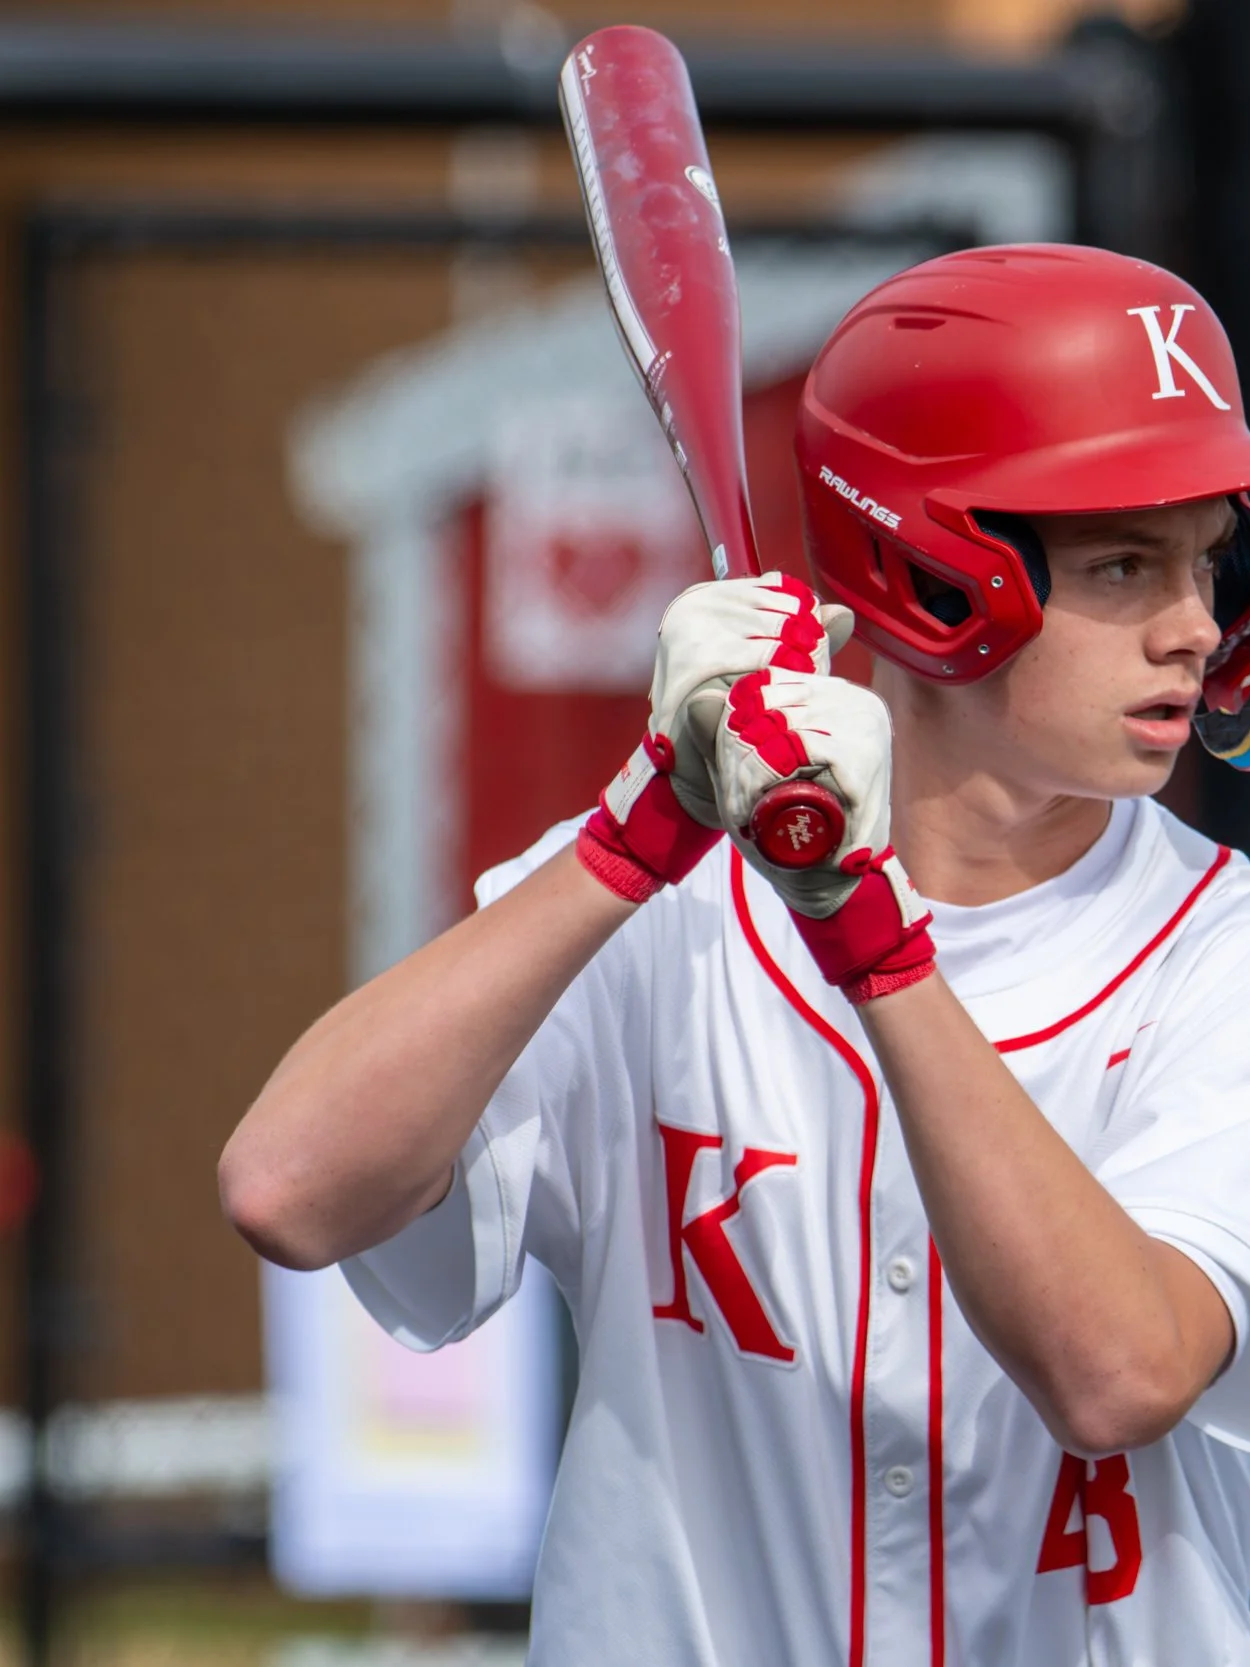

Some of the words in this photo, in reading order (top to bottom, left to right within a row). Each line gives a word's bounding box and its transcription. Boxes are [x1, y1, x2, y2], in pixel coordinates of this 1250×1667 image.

[1126, 303, 1232, 411] K
[818, 465, 903, 531] RAWLINGS
[652, 1122, 798, 1363] K
